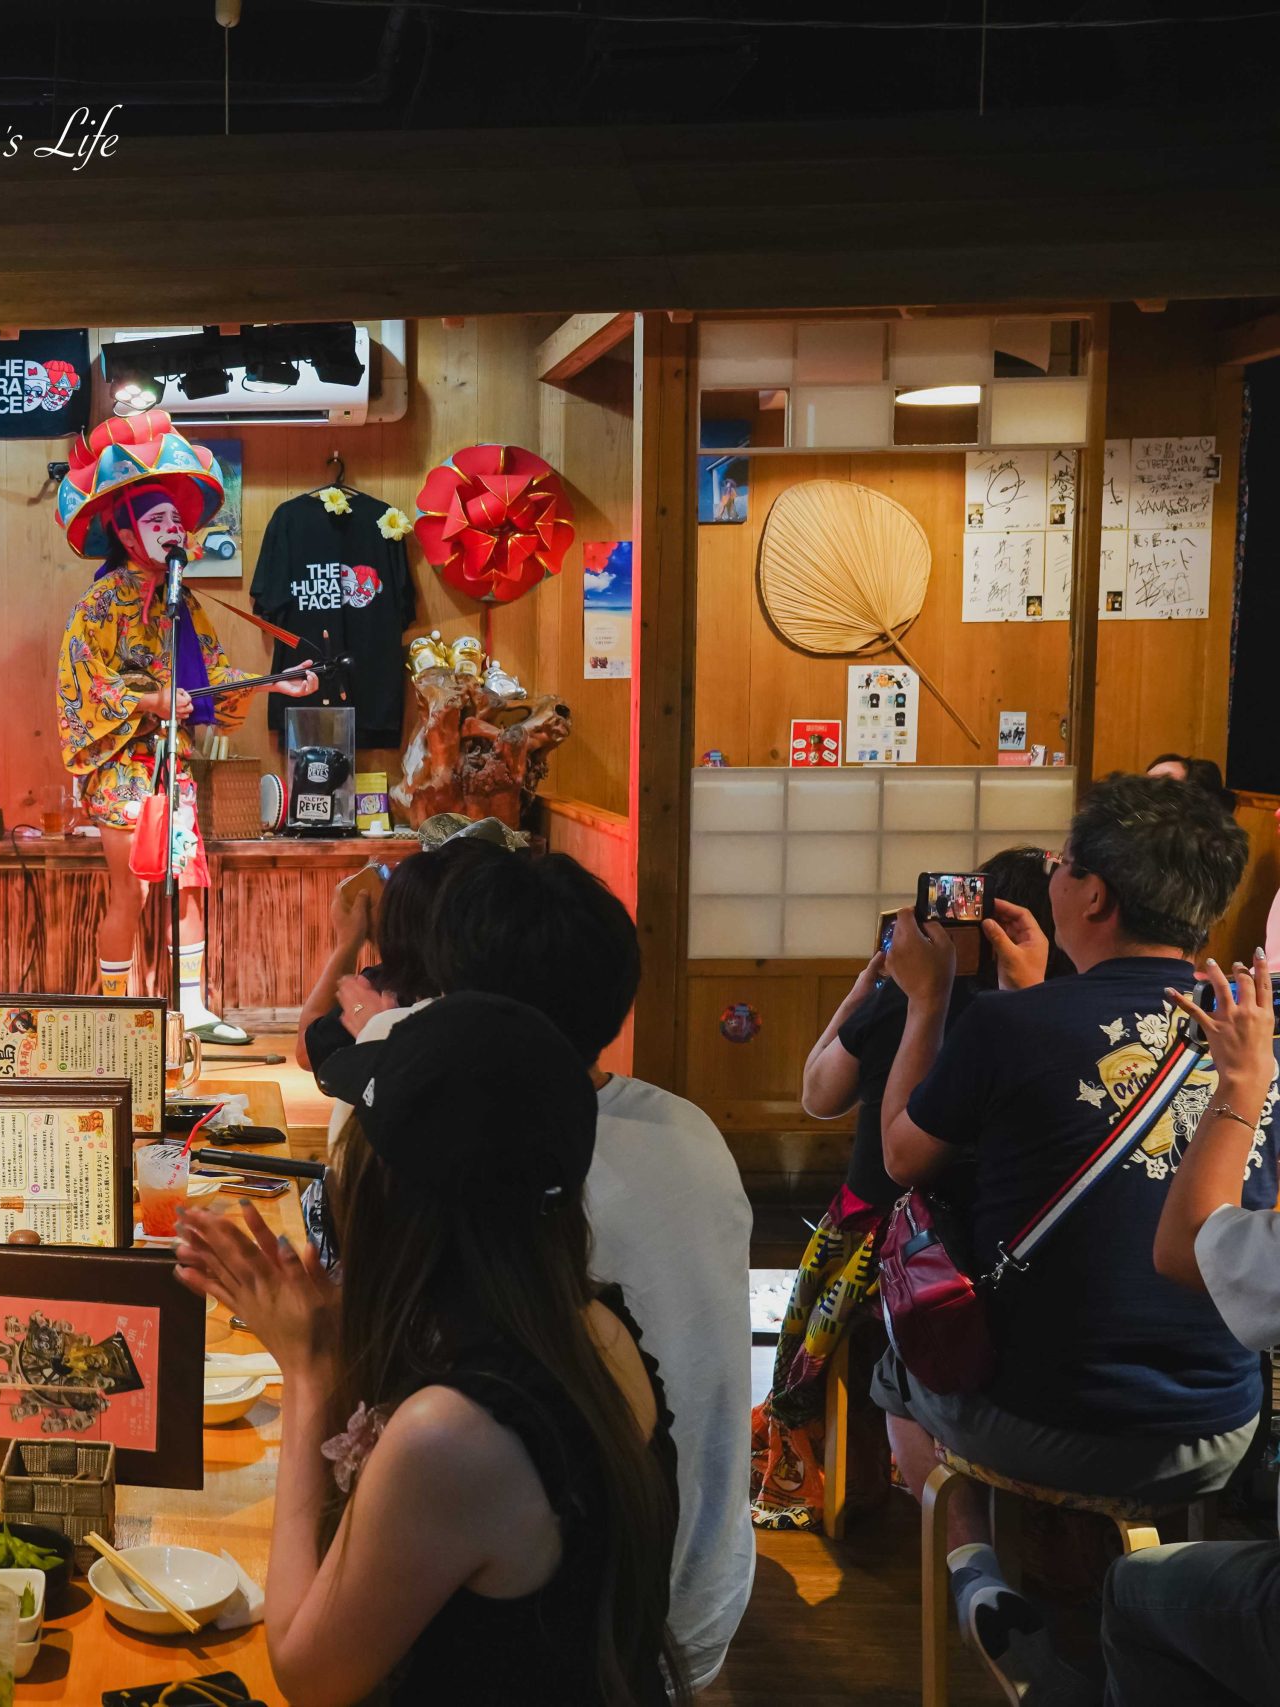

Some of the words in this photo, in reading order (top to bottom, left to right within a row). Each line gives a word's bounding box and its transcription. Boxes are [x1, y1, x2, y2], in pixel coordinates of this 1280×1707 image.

[306, 562, 340, 580] THE
[290, 578, 341, 597] HURA
[299, 593, 342, 611] FACE
[307, 766, 330, 780] REYES
[298, 800, 329, 815] REYES
[127, 1328, 137, 1343] OR
[135, 1318, 152, 1360] テキーラ
